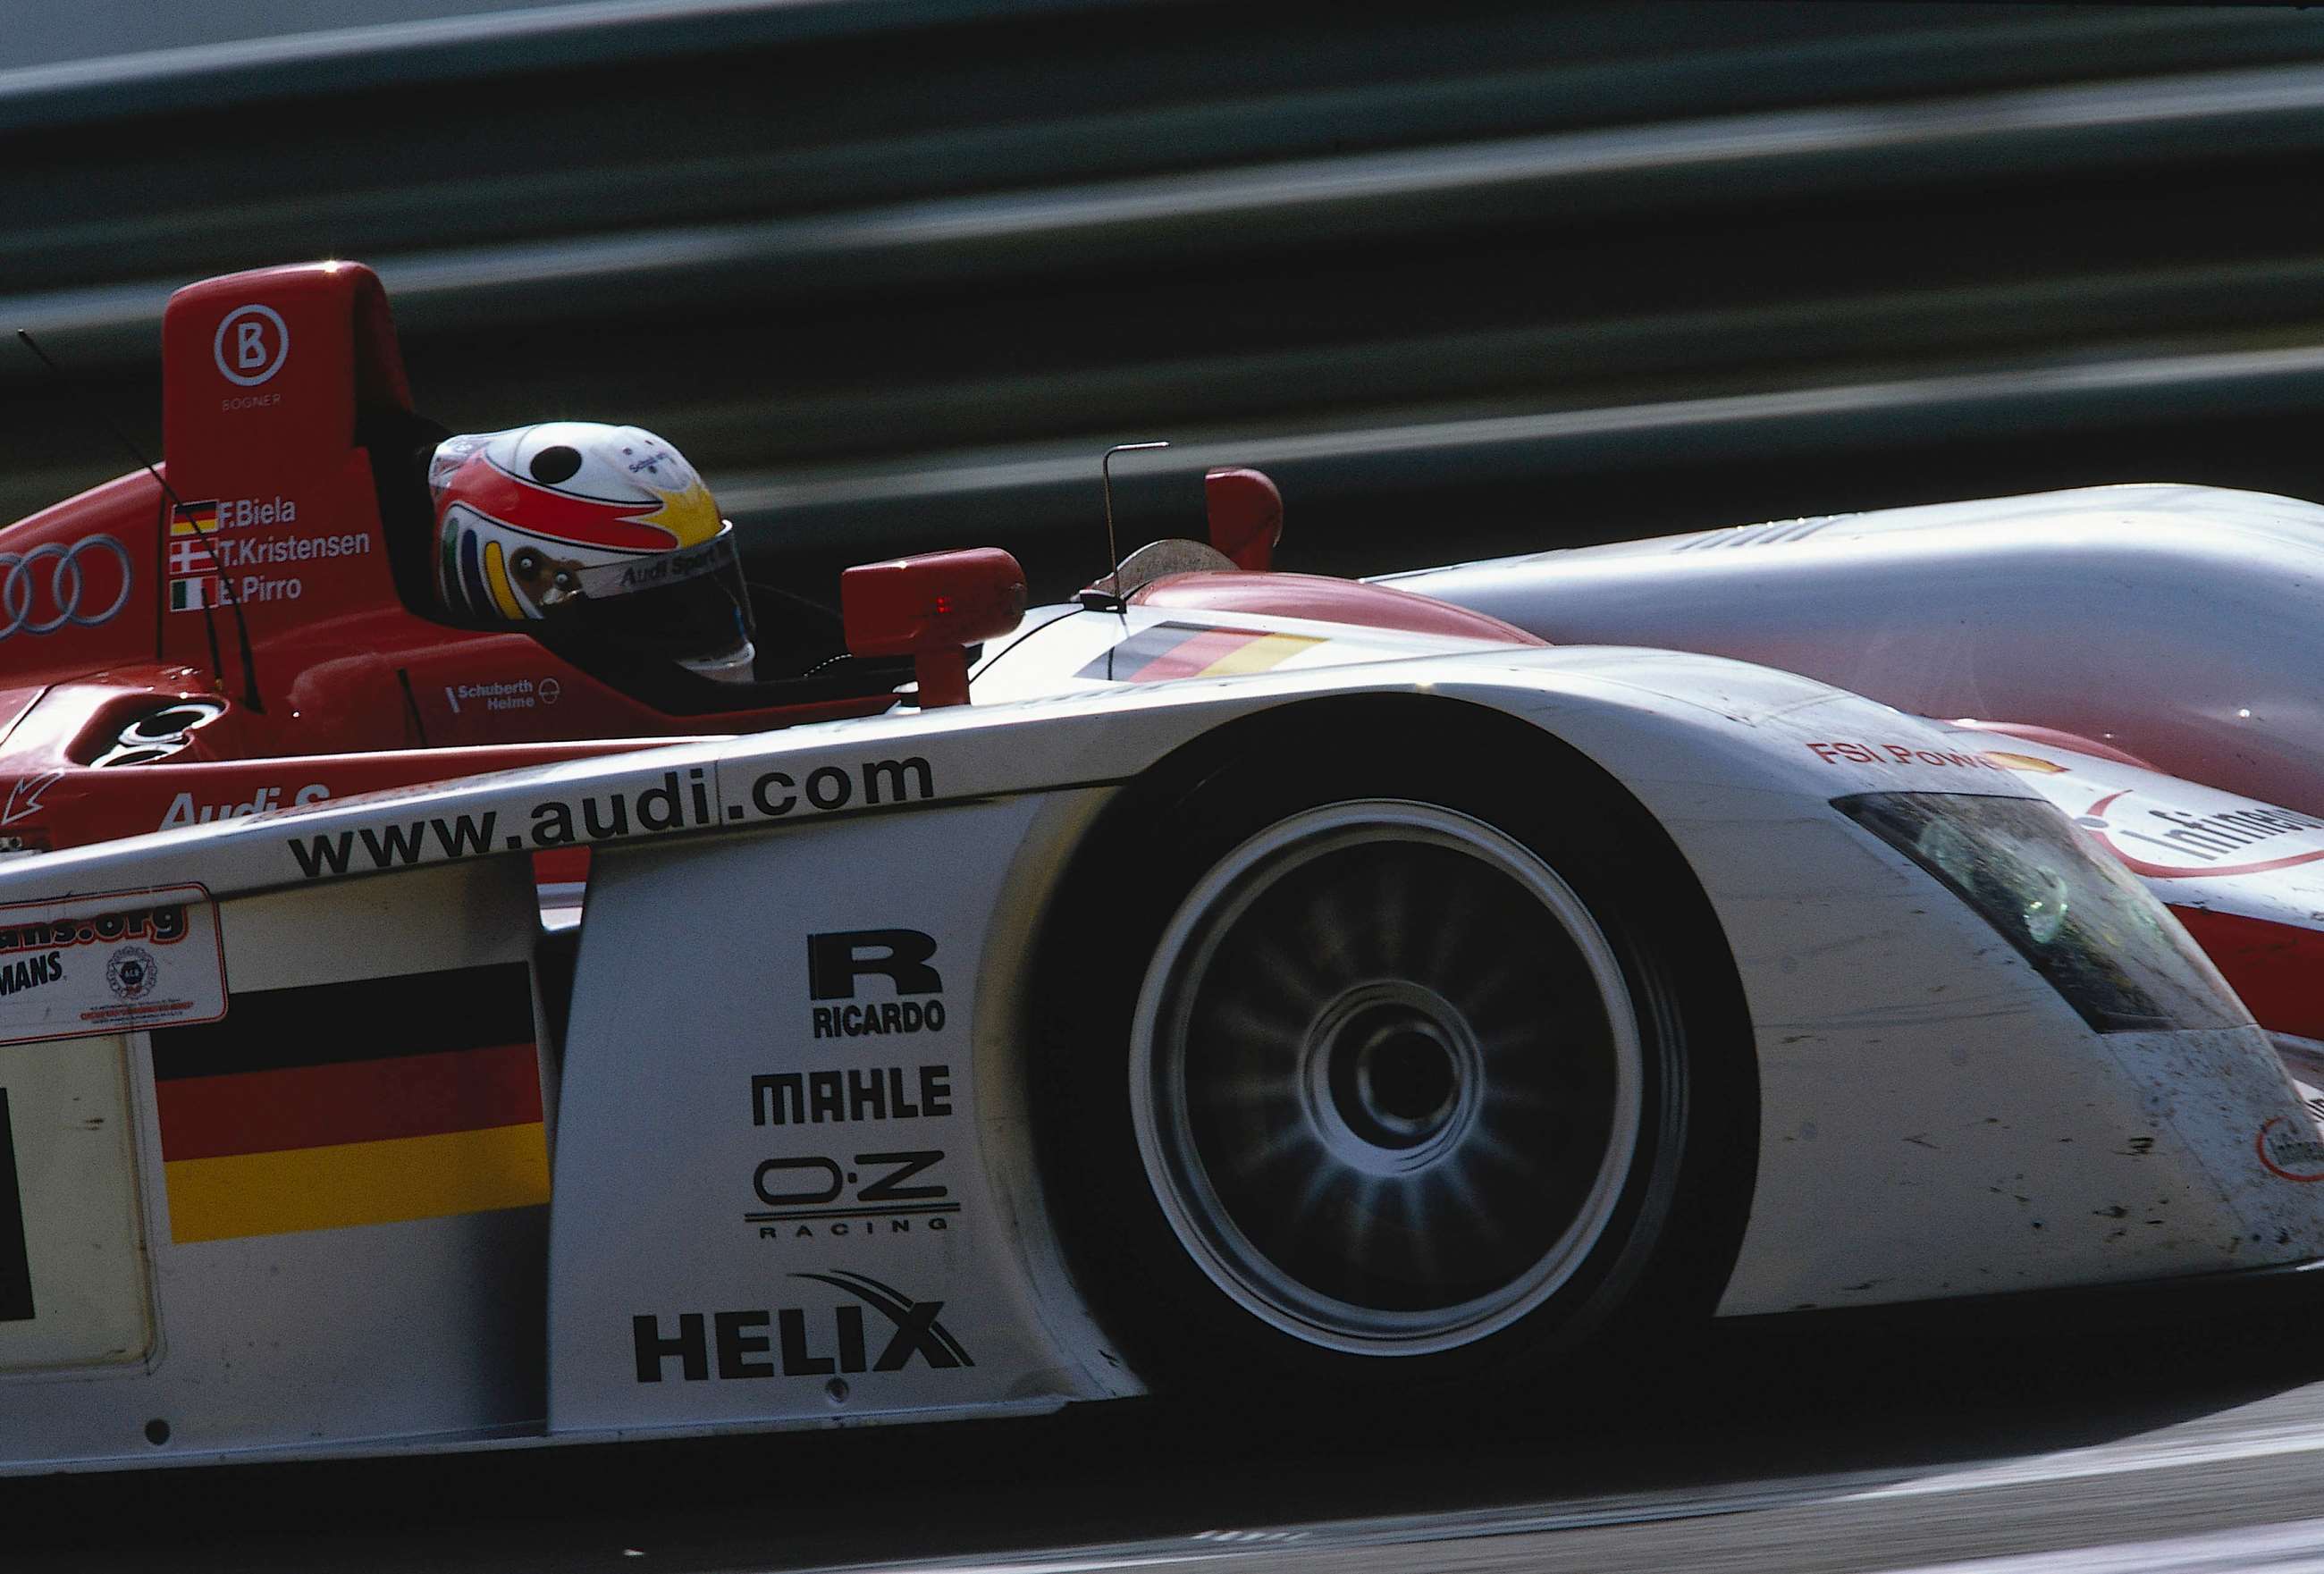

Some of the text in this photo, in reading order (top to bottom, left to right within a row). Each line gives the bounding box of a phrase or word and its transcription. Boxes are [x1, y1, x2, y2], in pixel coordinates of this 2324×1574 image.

[238, 322, 266, 368] B
[222, 393, 282, 412] BOGNER
[217, 496, 296, 529] F.Biela
[219, 533, 370, 566] T.Kristensen
[219, 576, 302, 605] E.Pirro
[458, 680, 534, 698] Schuberth
[487, 696, 535, 710] Helme
[1806, 742, 1885, 765] FSI
[289, 755, 935, 879] www.audi.com
[807, 929, 942, 999] R
[813, 1000, 945, 1038] RICARDO
[752, 1065, 952, 1125] MAHLE
[760, 1218, 947, 1238] RACING
[633, 1294, 974, 1383] HELIX
